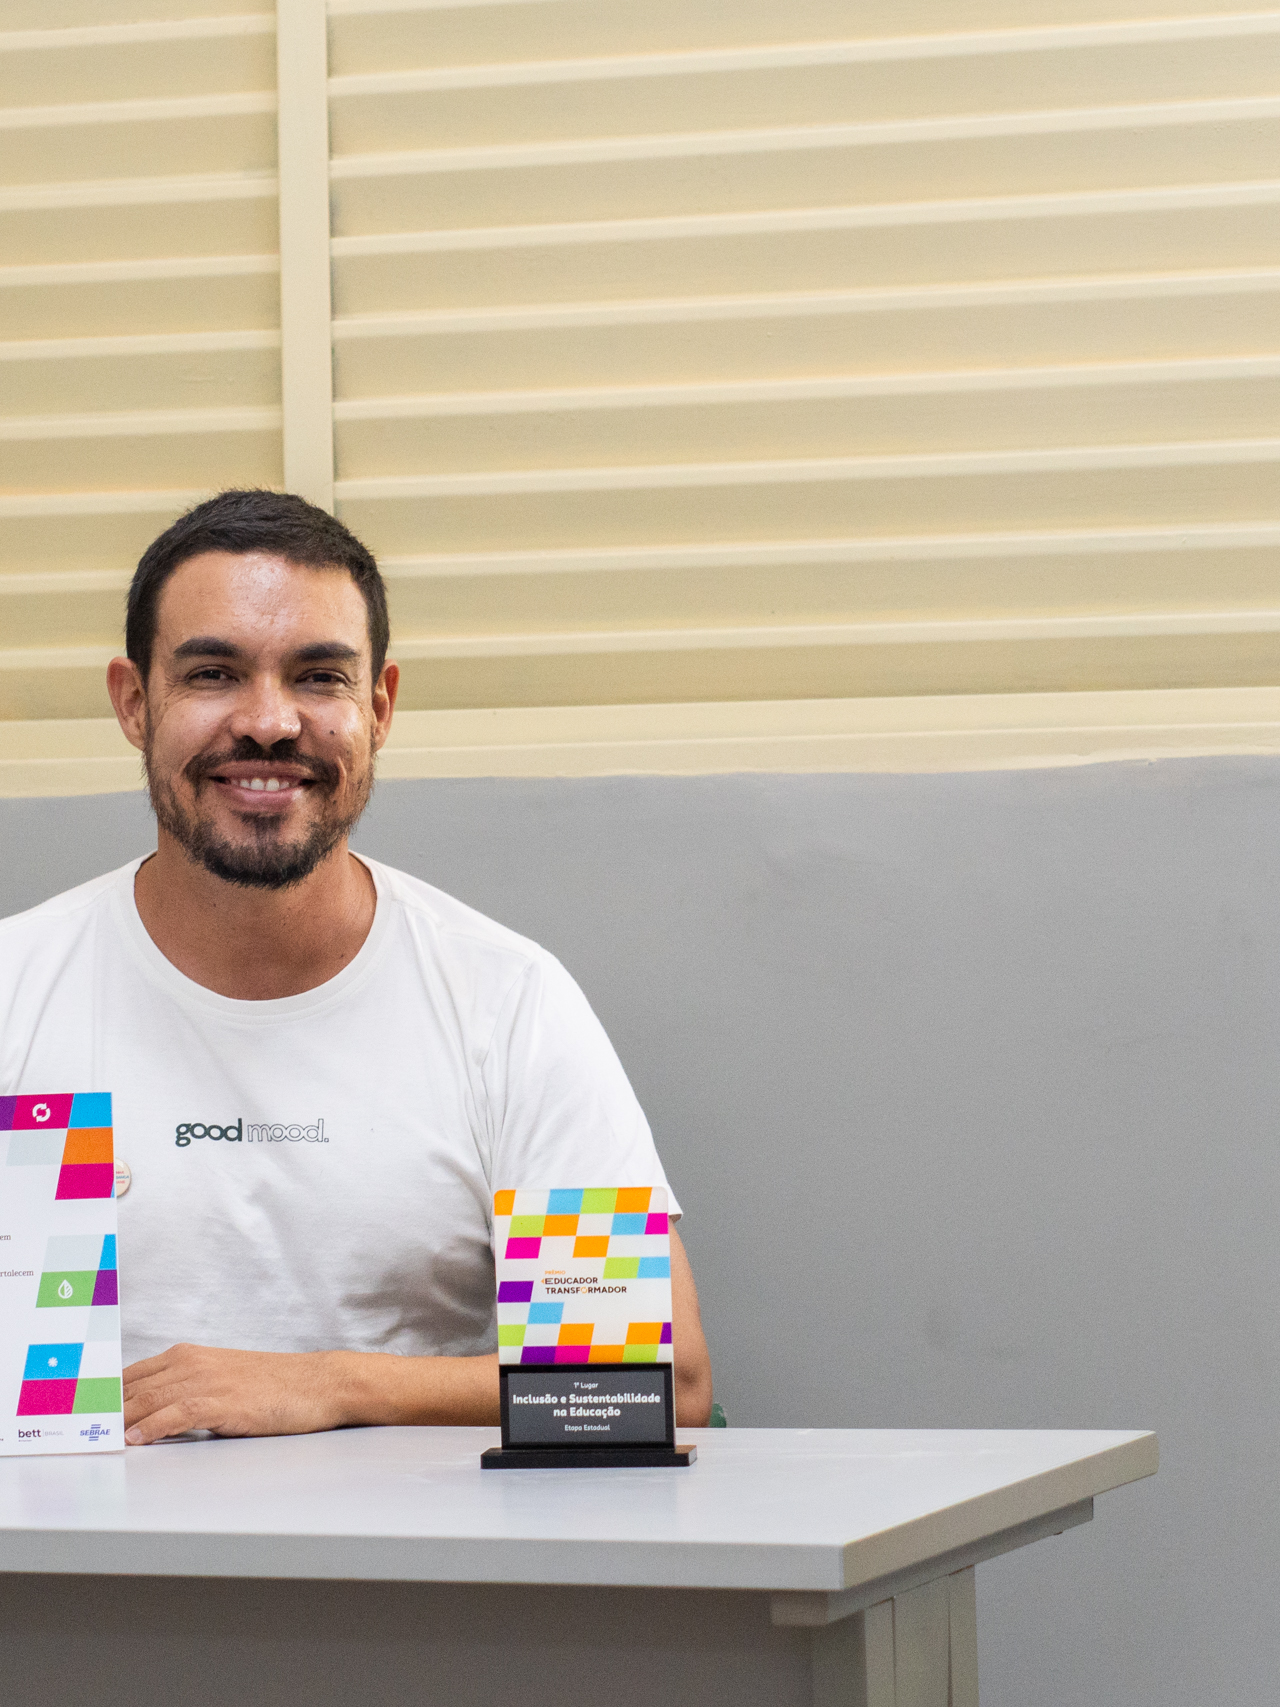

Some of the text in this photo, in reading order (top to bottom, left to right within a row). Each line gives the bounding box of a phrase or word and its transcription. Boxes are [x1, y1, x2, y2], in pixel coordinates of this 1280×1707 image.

[175, 1118, 242, 1147] good
[545, 1276, 598, 1285] EDUCADOR
[545, 1286, 627, 1294] TRANSFORMADOR
[513, 1393, 660, 1404] Inclusão e Sustentabilidade
[553, 1406, 621, 1419] na Educação
[18, 1429, 41, 1438] bett
